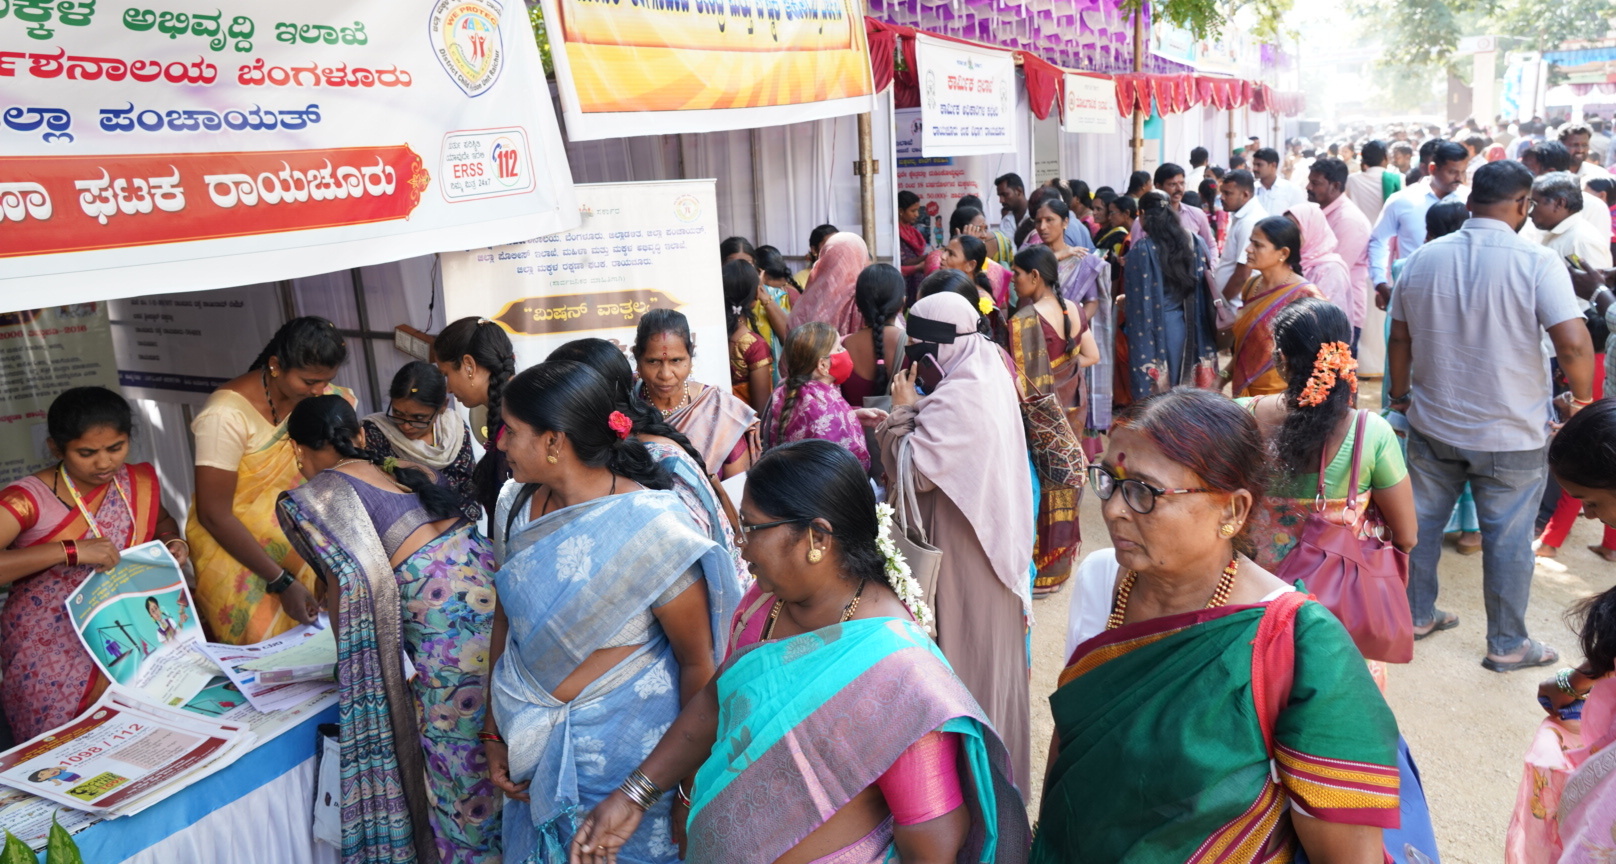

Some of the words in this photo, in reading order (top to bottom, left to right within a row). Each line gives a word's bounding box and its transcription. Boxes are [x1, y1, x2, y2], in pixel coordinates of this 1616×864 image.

[0, 0, 97, 40] ಕ್ಕಳ
[274, 21, 369, 46] ಇಲಾಖೆ
[447, 11, 459, 26] WE
[459, 6, 498, 25] PROTEC
[237, 57, 412, 88] ಬೆಂಗಳೂರು
[439, 48, 458, 76] District
[488, 50, 500, 77] Raichur
[0, 105, 74, 144] ಲ್ಲಾ
[99, 101, 322, 133] ಪಂಚಾಯತ್
[453, 162, 484, 179] ERSS
[497, 149, 518, 178] 112
[74, 163, 186, 225] ಘಟಕ
[203, 155, 396, 208] ರಾಯಚೂರು
[60, 746, 102, 766] 1098
[112, 723, 144, 740] 112
